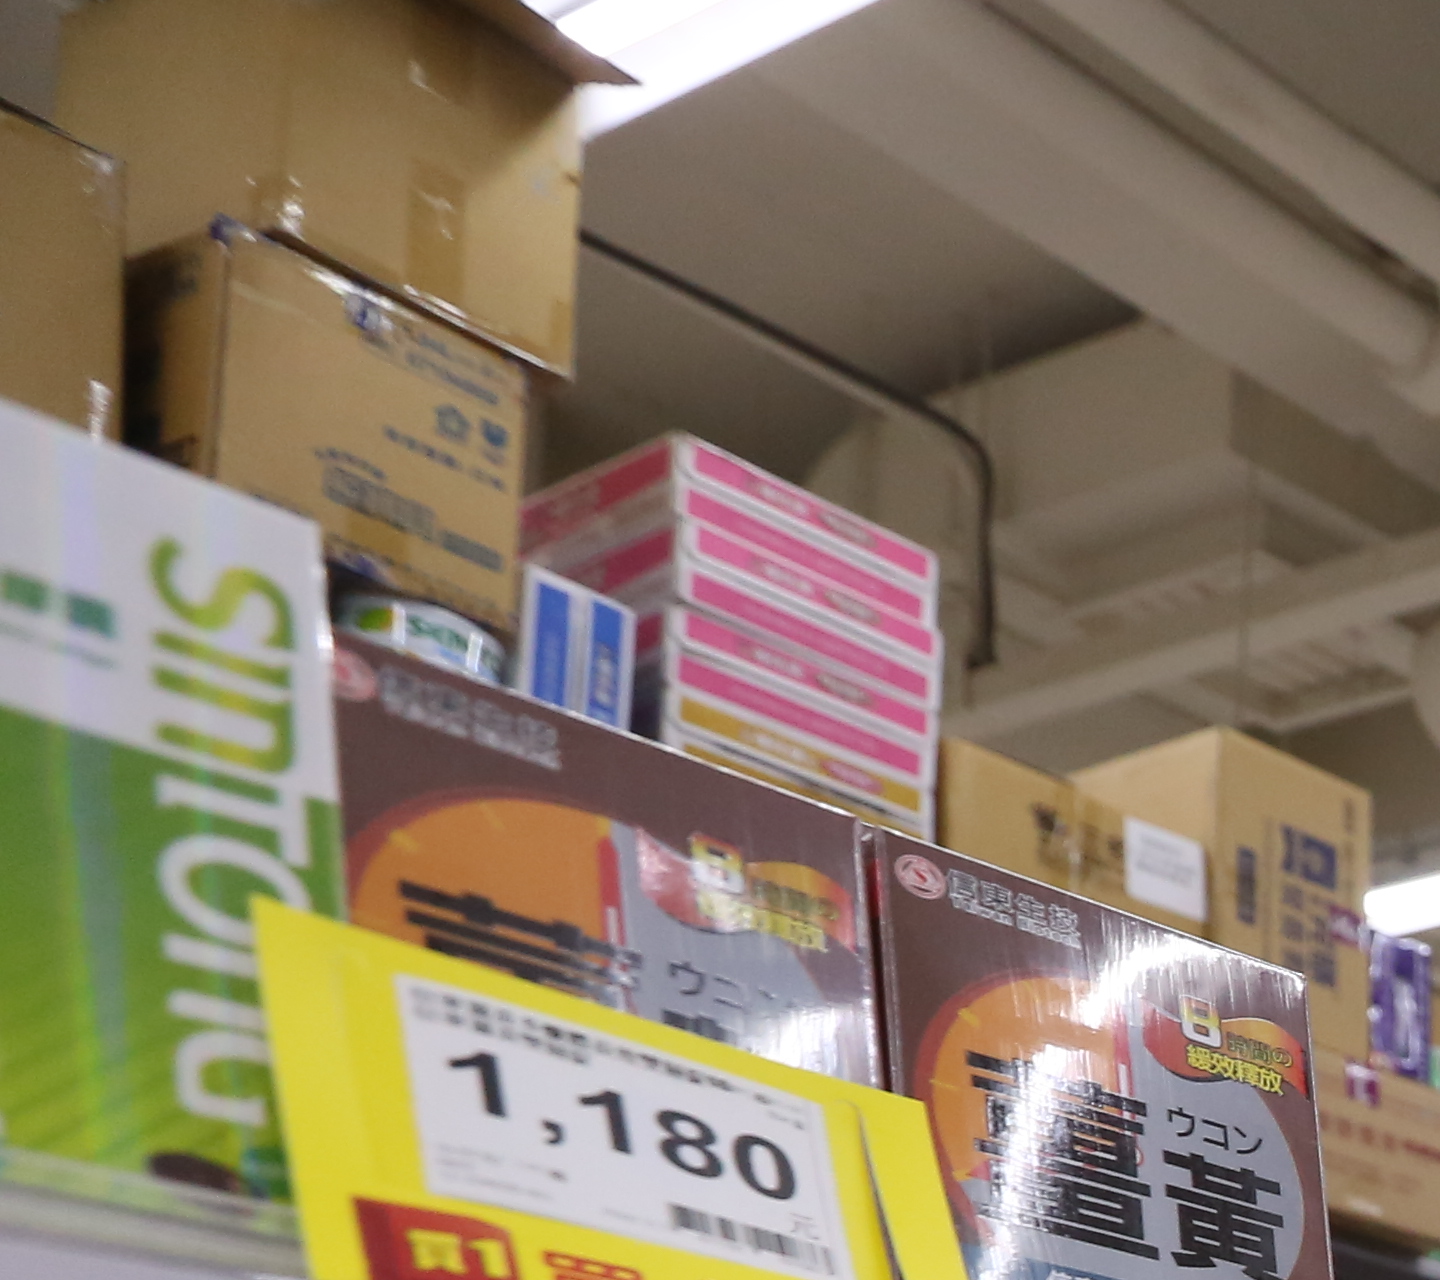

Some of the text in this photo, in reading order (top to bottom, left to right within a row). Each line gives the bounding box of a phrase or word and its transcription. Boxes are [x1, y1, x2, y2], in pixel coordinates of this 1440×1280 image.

[1180, 994, 1222, 1049] 8
[449, 1050, 797, 1202] 1,180
[1166, 1106, 1264, 1155] ウコン
